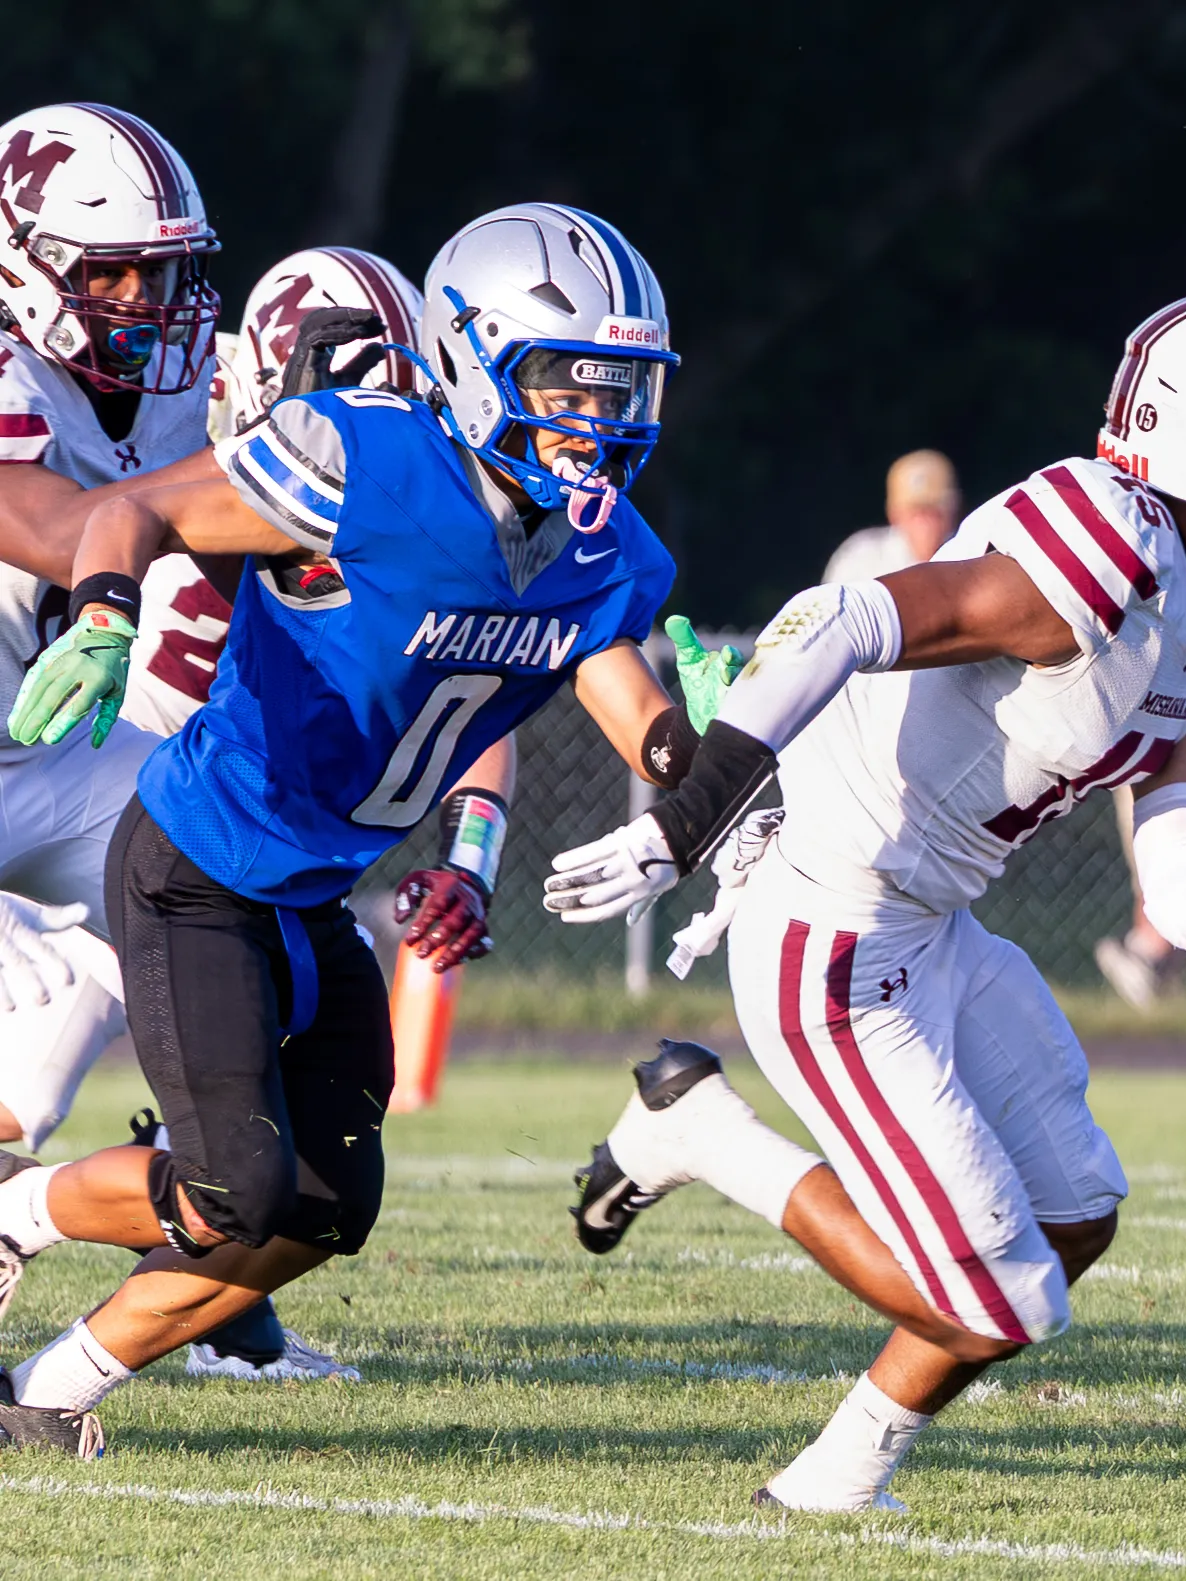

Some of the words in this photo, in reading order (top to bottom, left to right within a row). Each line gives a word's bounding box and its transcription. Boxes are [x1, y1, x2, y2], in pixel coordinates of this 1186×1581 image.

[0, 129, 77, 214] M
[608, 324, 659, 344] Riddell
[1138, 404, 1156, 431] 15
[403, 611, 580, 671] MARIAN
[350, 673, 504, 829] 0
